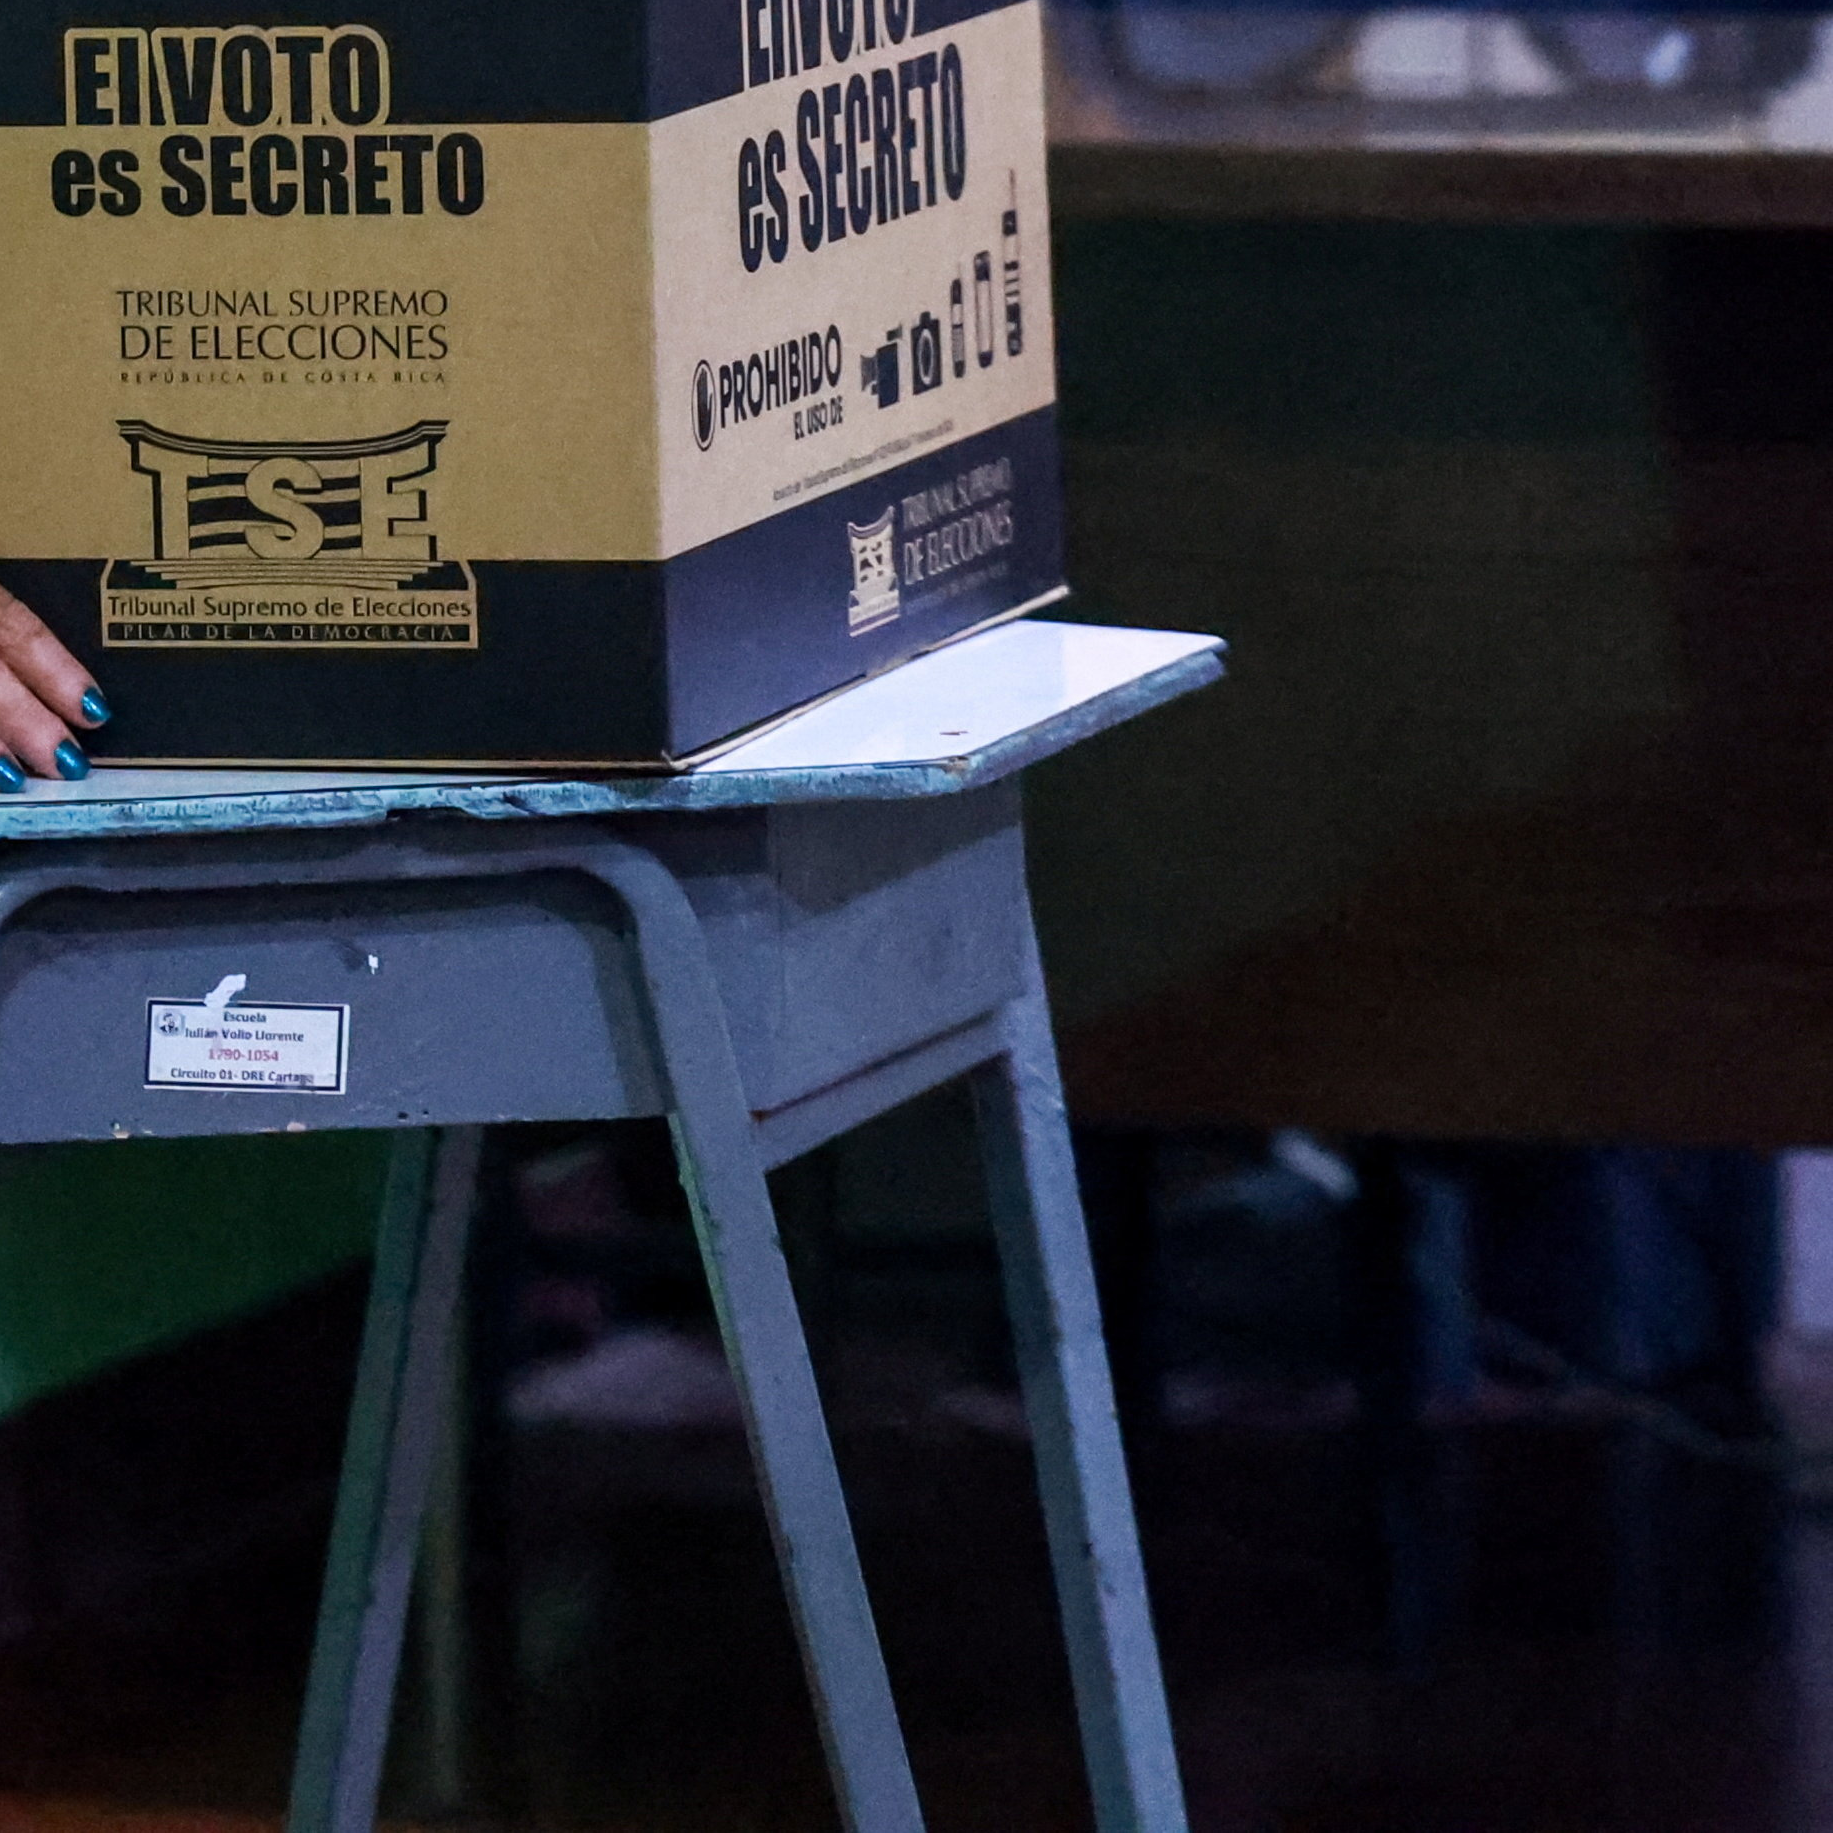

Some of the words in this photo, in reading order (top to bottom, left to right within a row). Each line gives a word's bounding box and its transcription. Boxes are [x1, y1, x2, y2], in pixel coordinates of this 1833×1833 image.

[161, 34, 381, 126] VOTO
[738, 129, 789, 273] es
[796, 42, 967, 253] SECRETO
[51, 148, 141, 217] es
[161, 132, 485, 217] SECRETO
[117, 289, 278, 317] TRIBUNAL
[289, 289, 449, 317] SUPREMO
[120, 324, 174, 361] DE
[191, 323, 449, 361] ELECCIONES
[263, 370, 289, 385] DE
[719, 324, 842, 429] PROHIBIDO
[831, 394, 843, 425] DE
[131, 439, 437, 561] TSE
[107, 595, 195, 616] Tribunal
[204, 596, 308, 622] Supremo
[314, 595, 345, 616] de
[353, 596, 472, 617] Elecciones
[122, 624, 192, 640] PILAR
[206, 624, 232, 640] DE
[248, 624, 277, 640] LA
[291, 624, 455, 640] DEMOCRACIA
[223, 1011, 267, 1023] Escuela
[170, 1067, 216, 1080] Circuito
